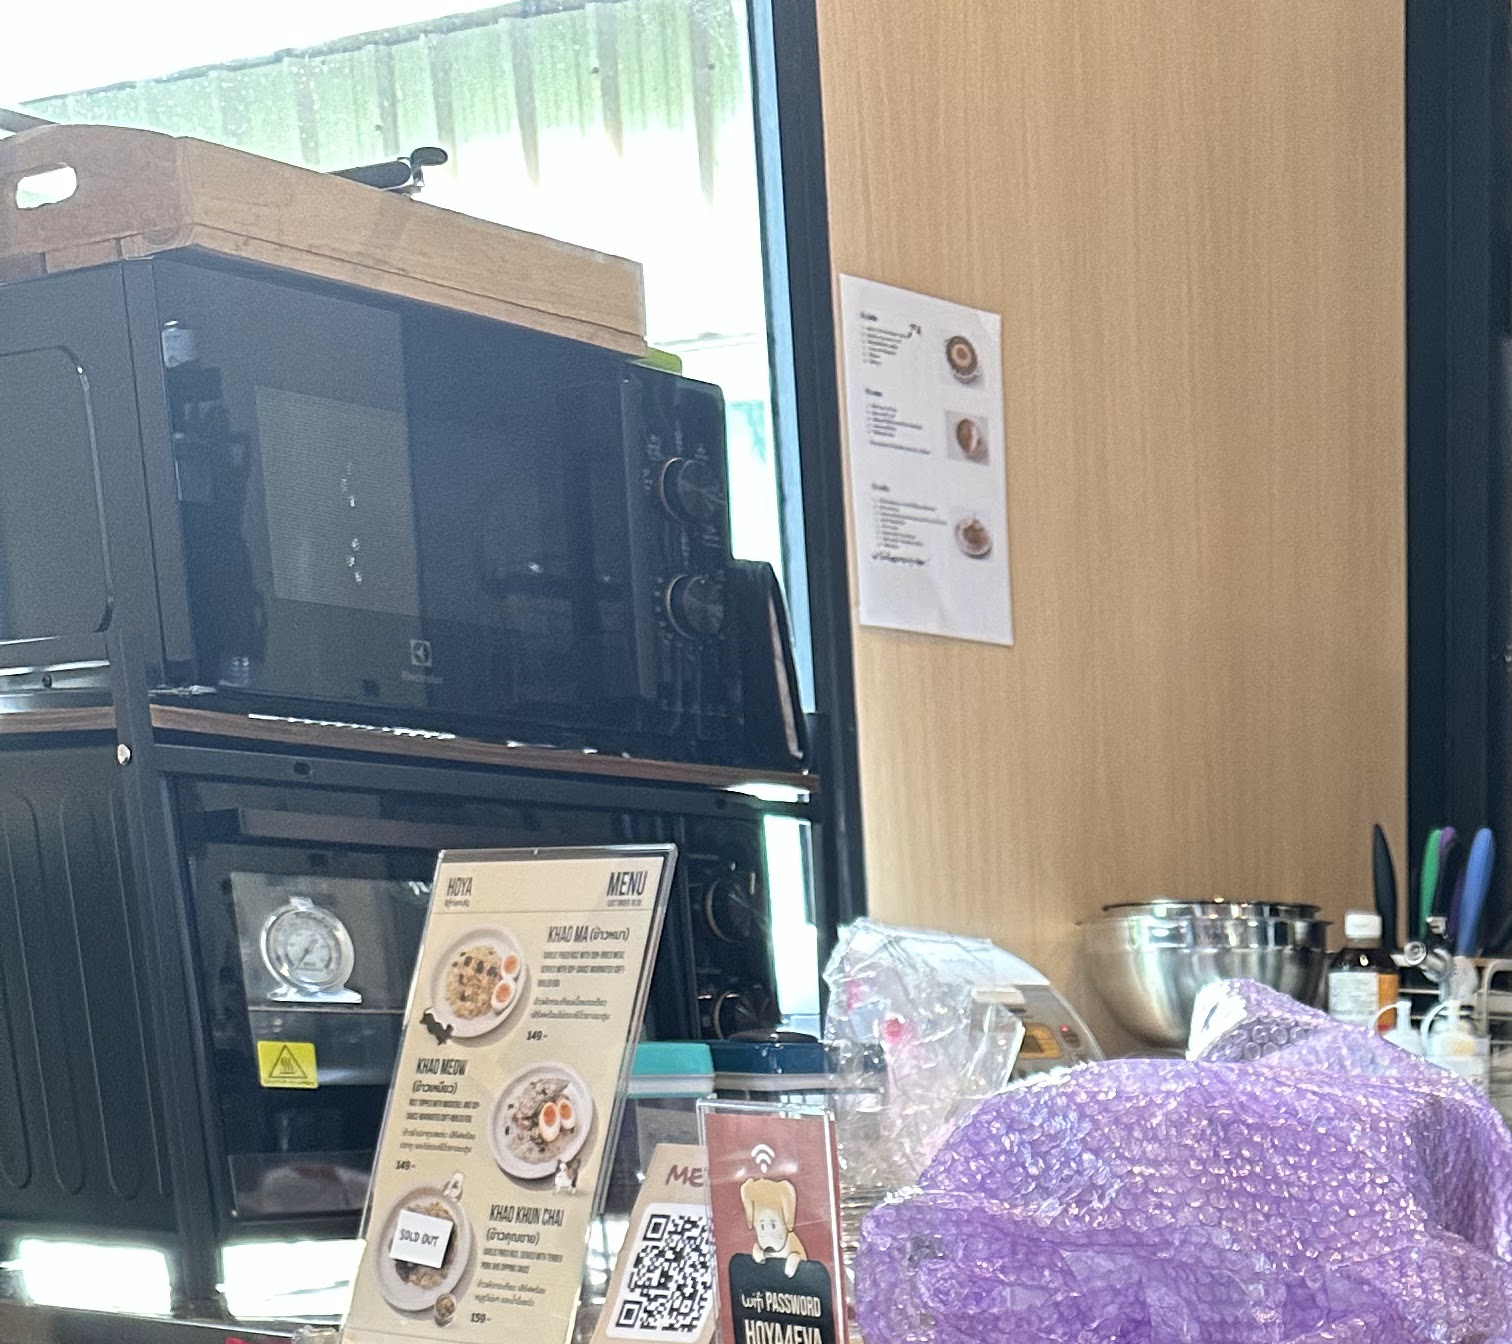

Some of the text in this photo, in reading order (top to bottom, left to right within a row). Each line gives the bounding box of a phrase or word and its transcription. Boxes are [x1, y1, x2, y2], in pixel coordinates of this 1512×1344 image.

[446, 876, 473, 897] HOYA
[606, 870, 649, 897] MENU
[547, 926, 574, 943] KHAO
[573, 925, 590, 943] MA
[416, 1058, 468, 1076] KHAO MEOW
[489, 1204, 565, 1228] KHAO KHUN CHAI
[400, 1228, 440, 1247] SOLD OUT
[765, 1291, 822, 1318] PASSWORD
